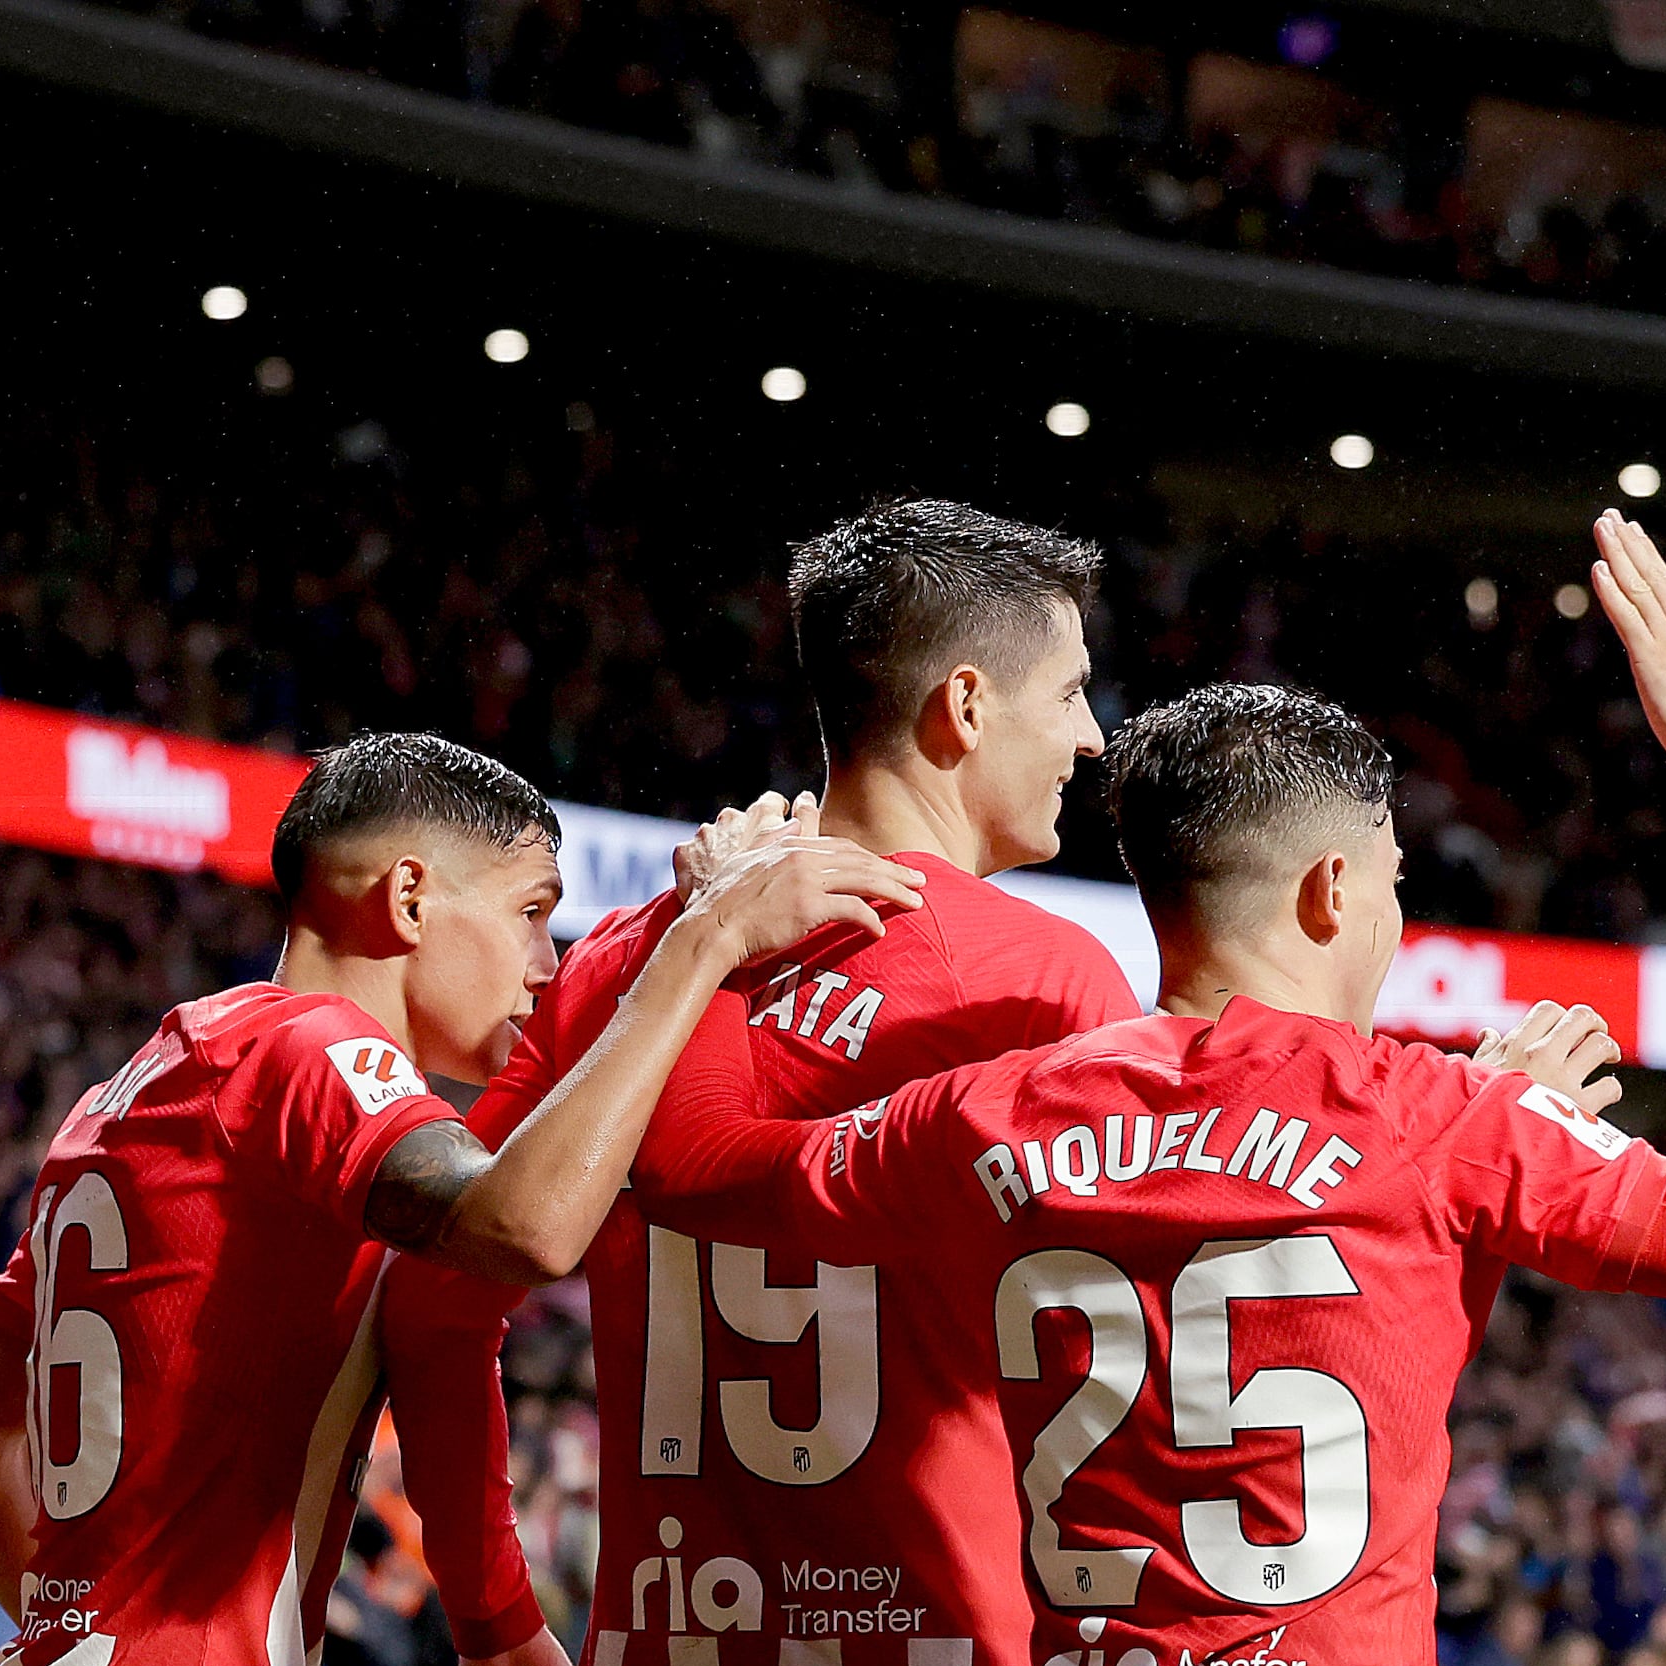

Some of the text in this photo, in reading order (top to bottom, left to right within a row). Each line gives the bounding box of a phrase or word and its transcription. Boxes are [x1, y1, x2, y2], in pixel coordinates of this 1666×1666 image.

[748, 962, 885, 1061] ATA
[972, 1107, 1364, 1224] RIQUELME
[641, 1223, 880, 1486] 19
[994, 1235, 1370, 1607] 25
[632, 1515, 901, 1633] ria Money
[780, 1599, 928, 1635] Transfer
